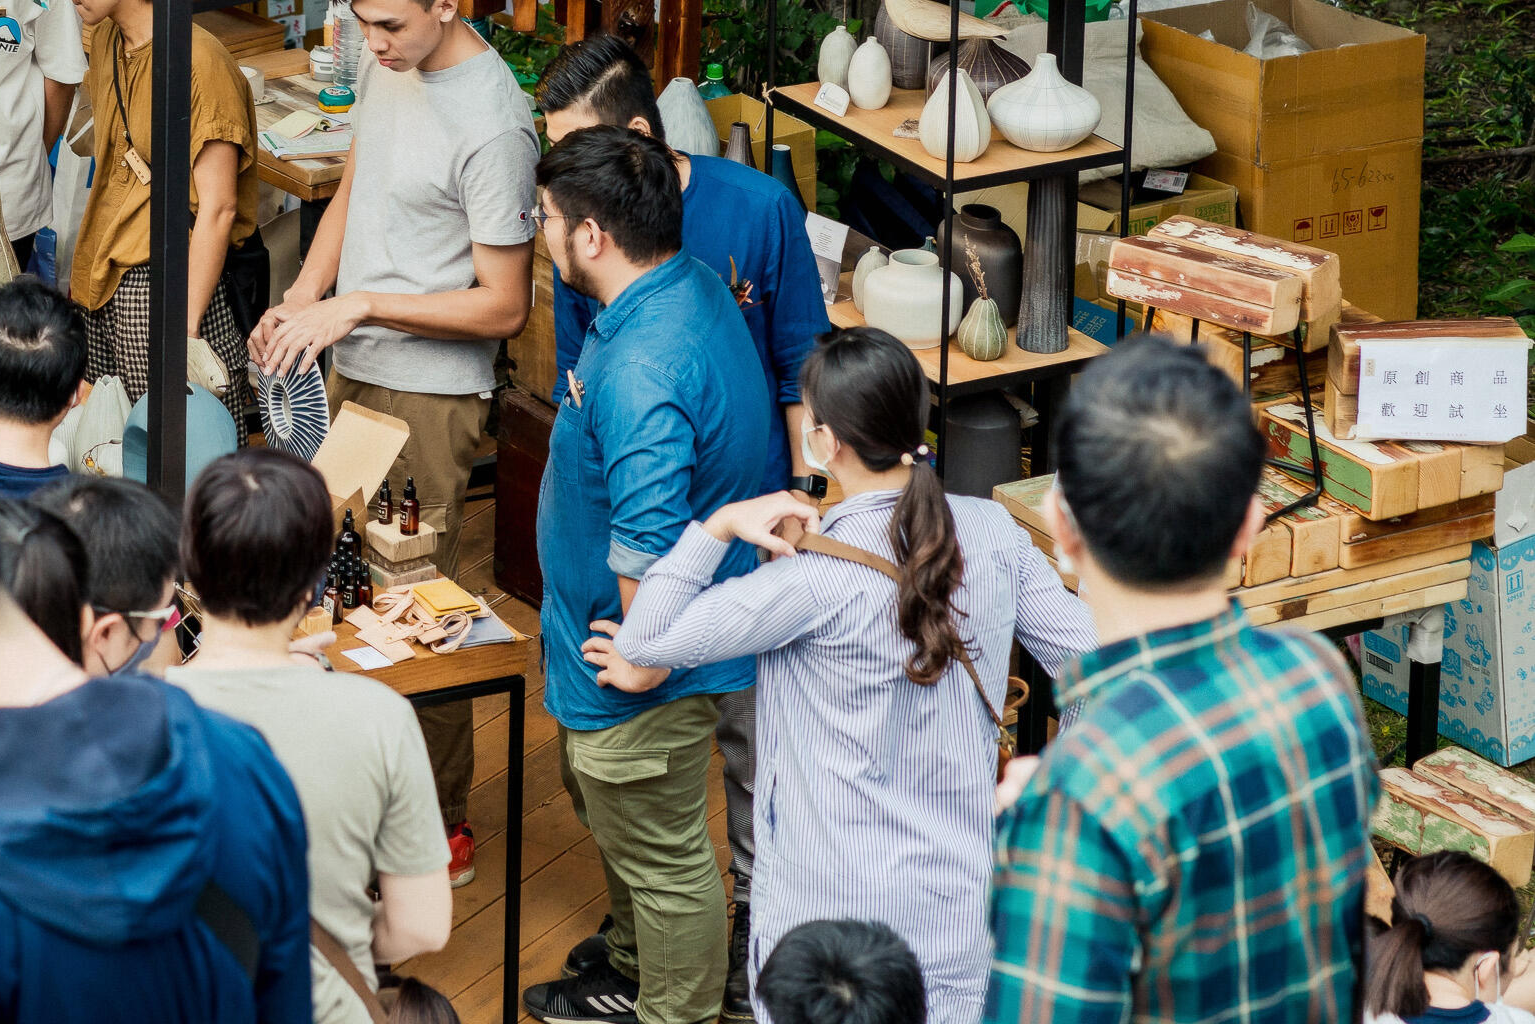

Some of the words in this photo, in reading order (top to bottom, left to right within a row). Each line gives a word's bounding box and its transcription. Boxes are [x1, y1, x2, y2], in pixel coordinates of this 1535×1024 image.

[1383, 370, 1508, 386] 原創商品
[1381, 403, 1508, 419] 歡迎試坐
